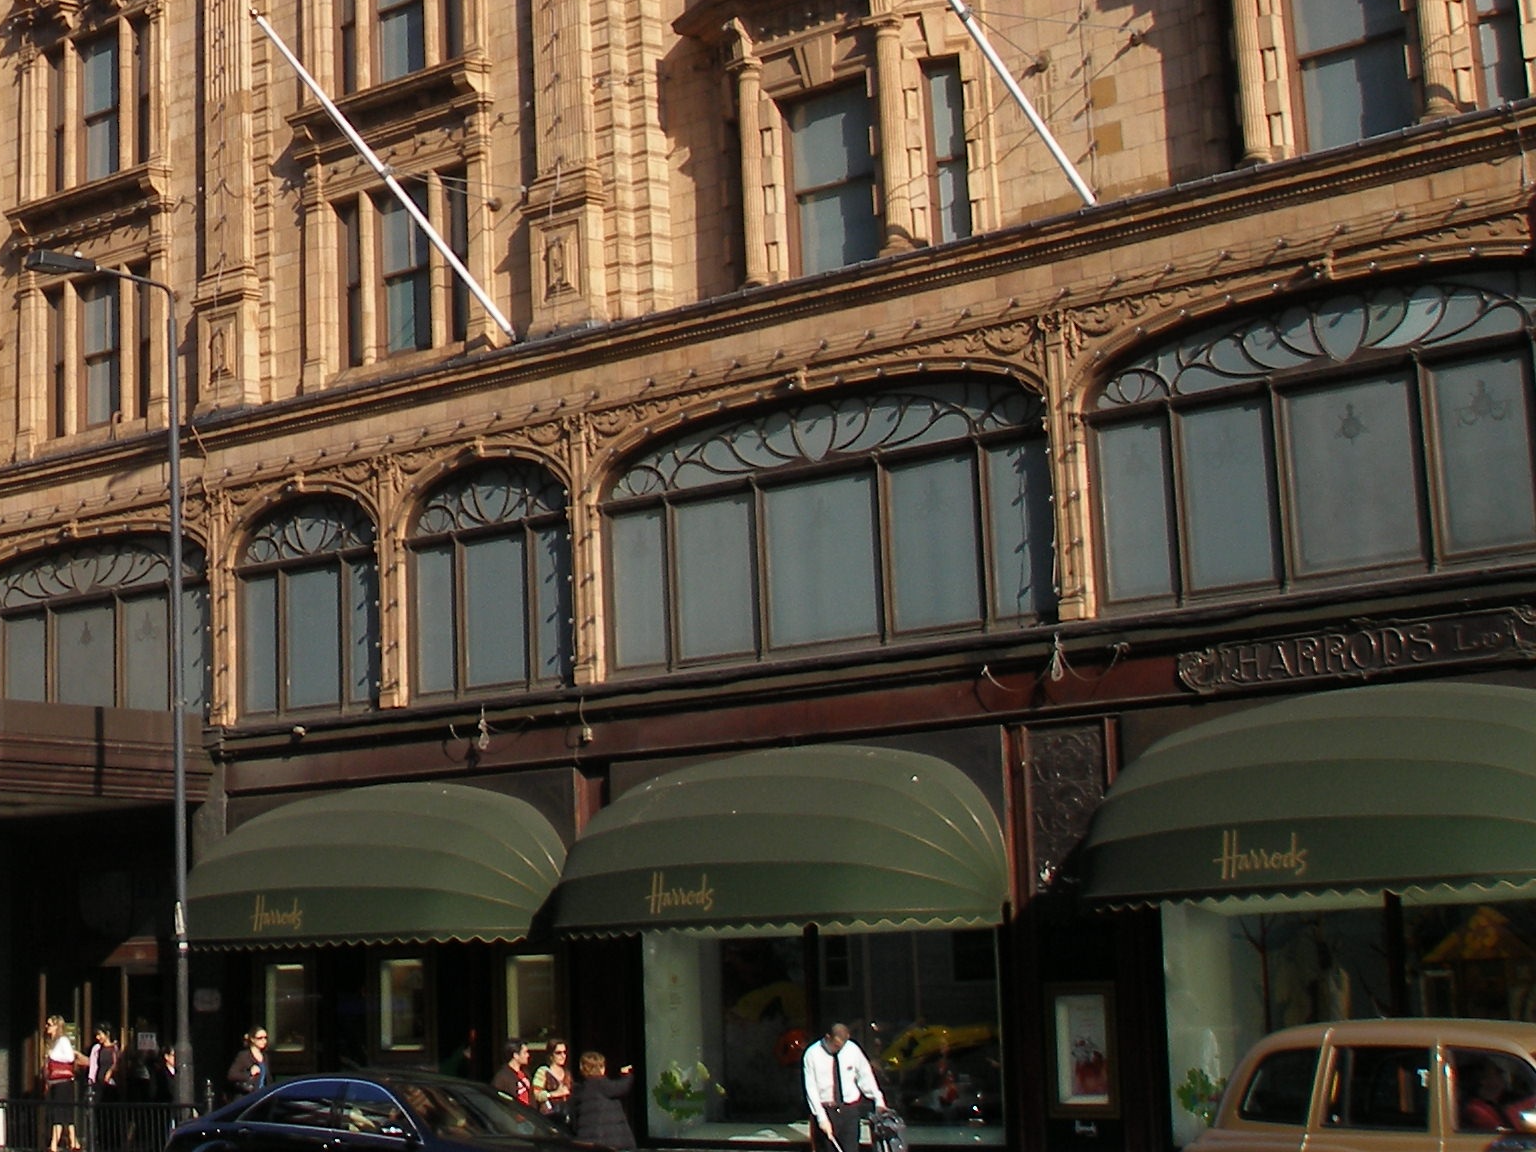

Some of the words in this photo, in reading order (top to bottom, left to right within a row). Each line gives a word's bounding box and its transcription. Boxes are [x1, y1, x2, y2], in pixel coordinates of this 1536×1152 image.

[1232, 622, 1437, 681] HARRODS
[1211, 829, 1309, 881] Harrods
[249, 894, 303, 933] Harrods
[644, 870, 715, 916] Harrods
